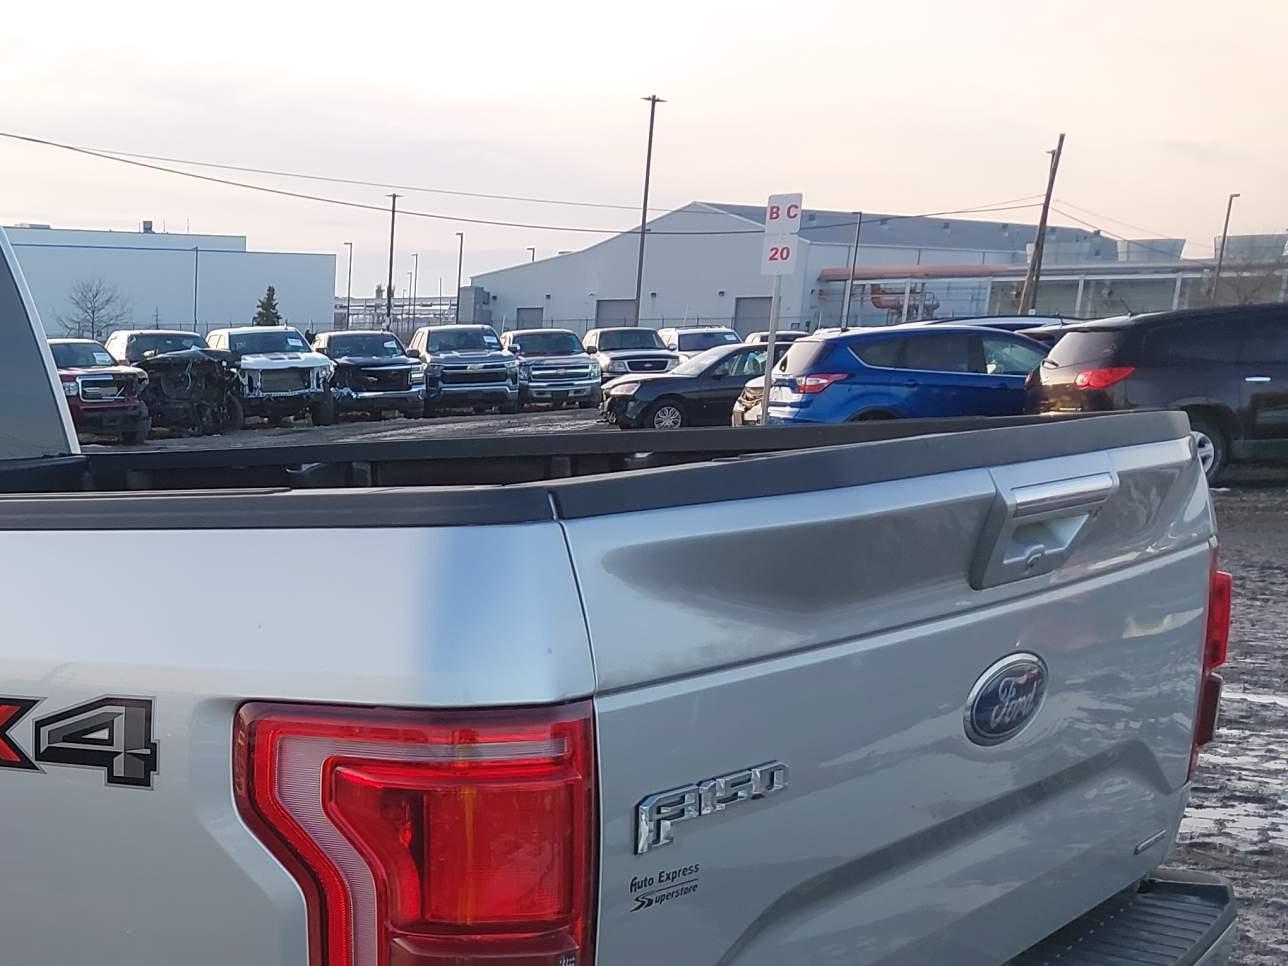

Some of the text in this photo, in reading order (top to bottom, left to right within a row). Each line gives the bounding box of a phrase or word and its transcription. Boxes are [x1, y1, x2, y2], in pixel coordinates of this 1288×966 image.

[769, 204, 799, 220] B C
[768, 246, 790, 261] 20
[989, 667, 1040, 729] Ford
[629, 863, 700, 894] Auto Express
[629, 883, 699, 913] Superstore
